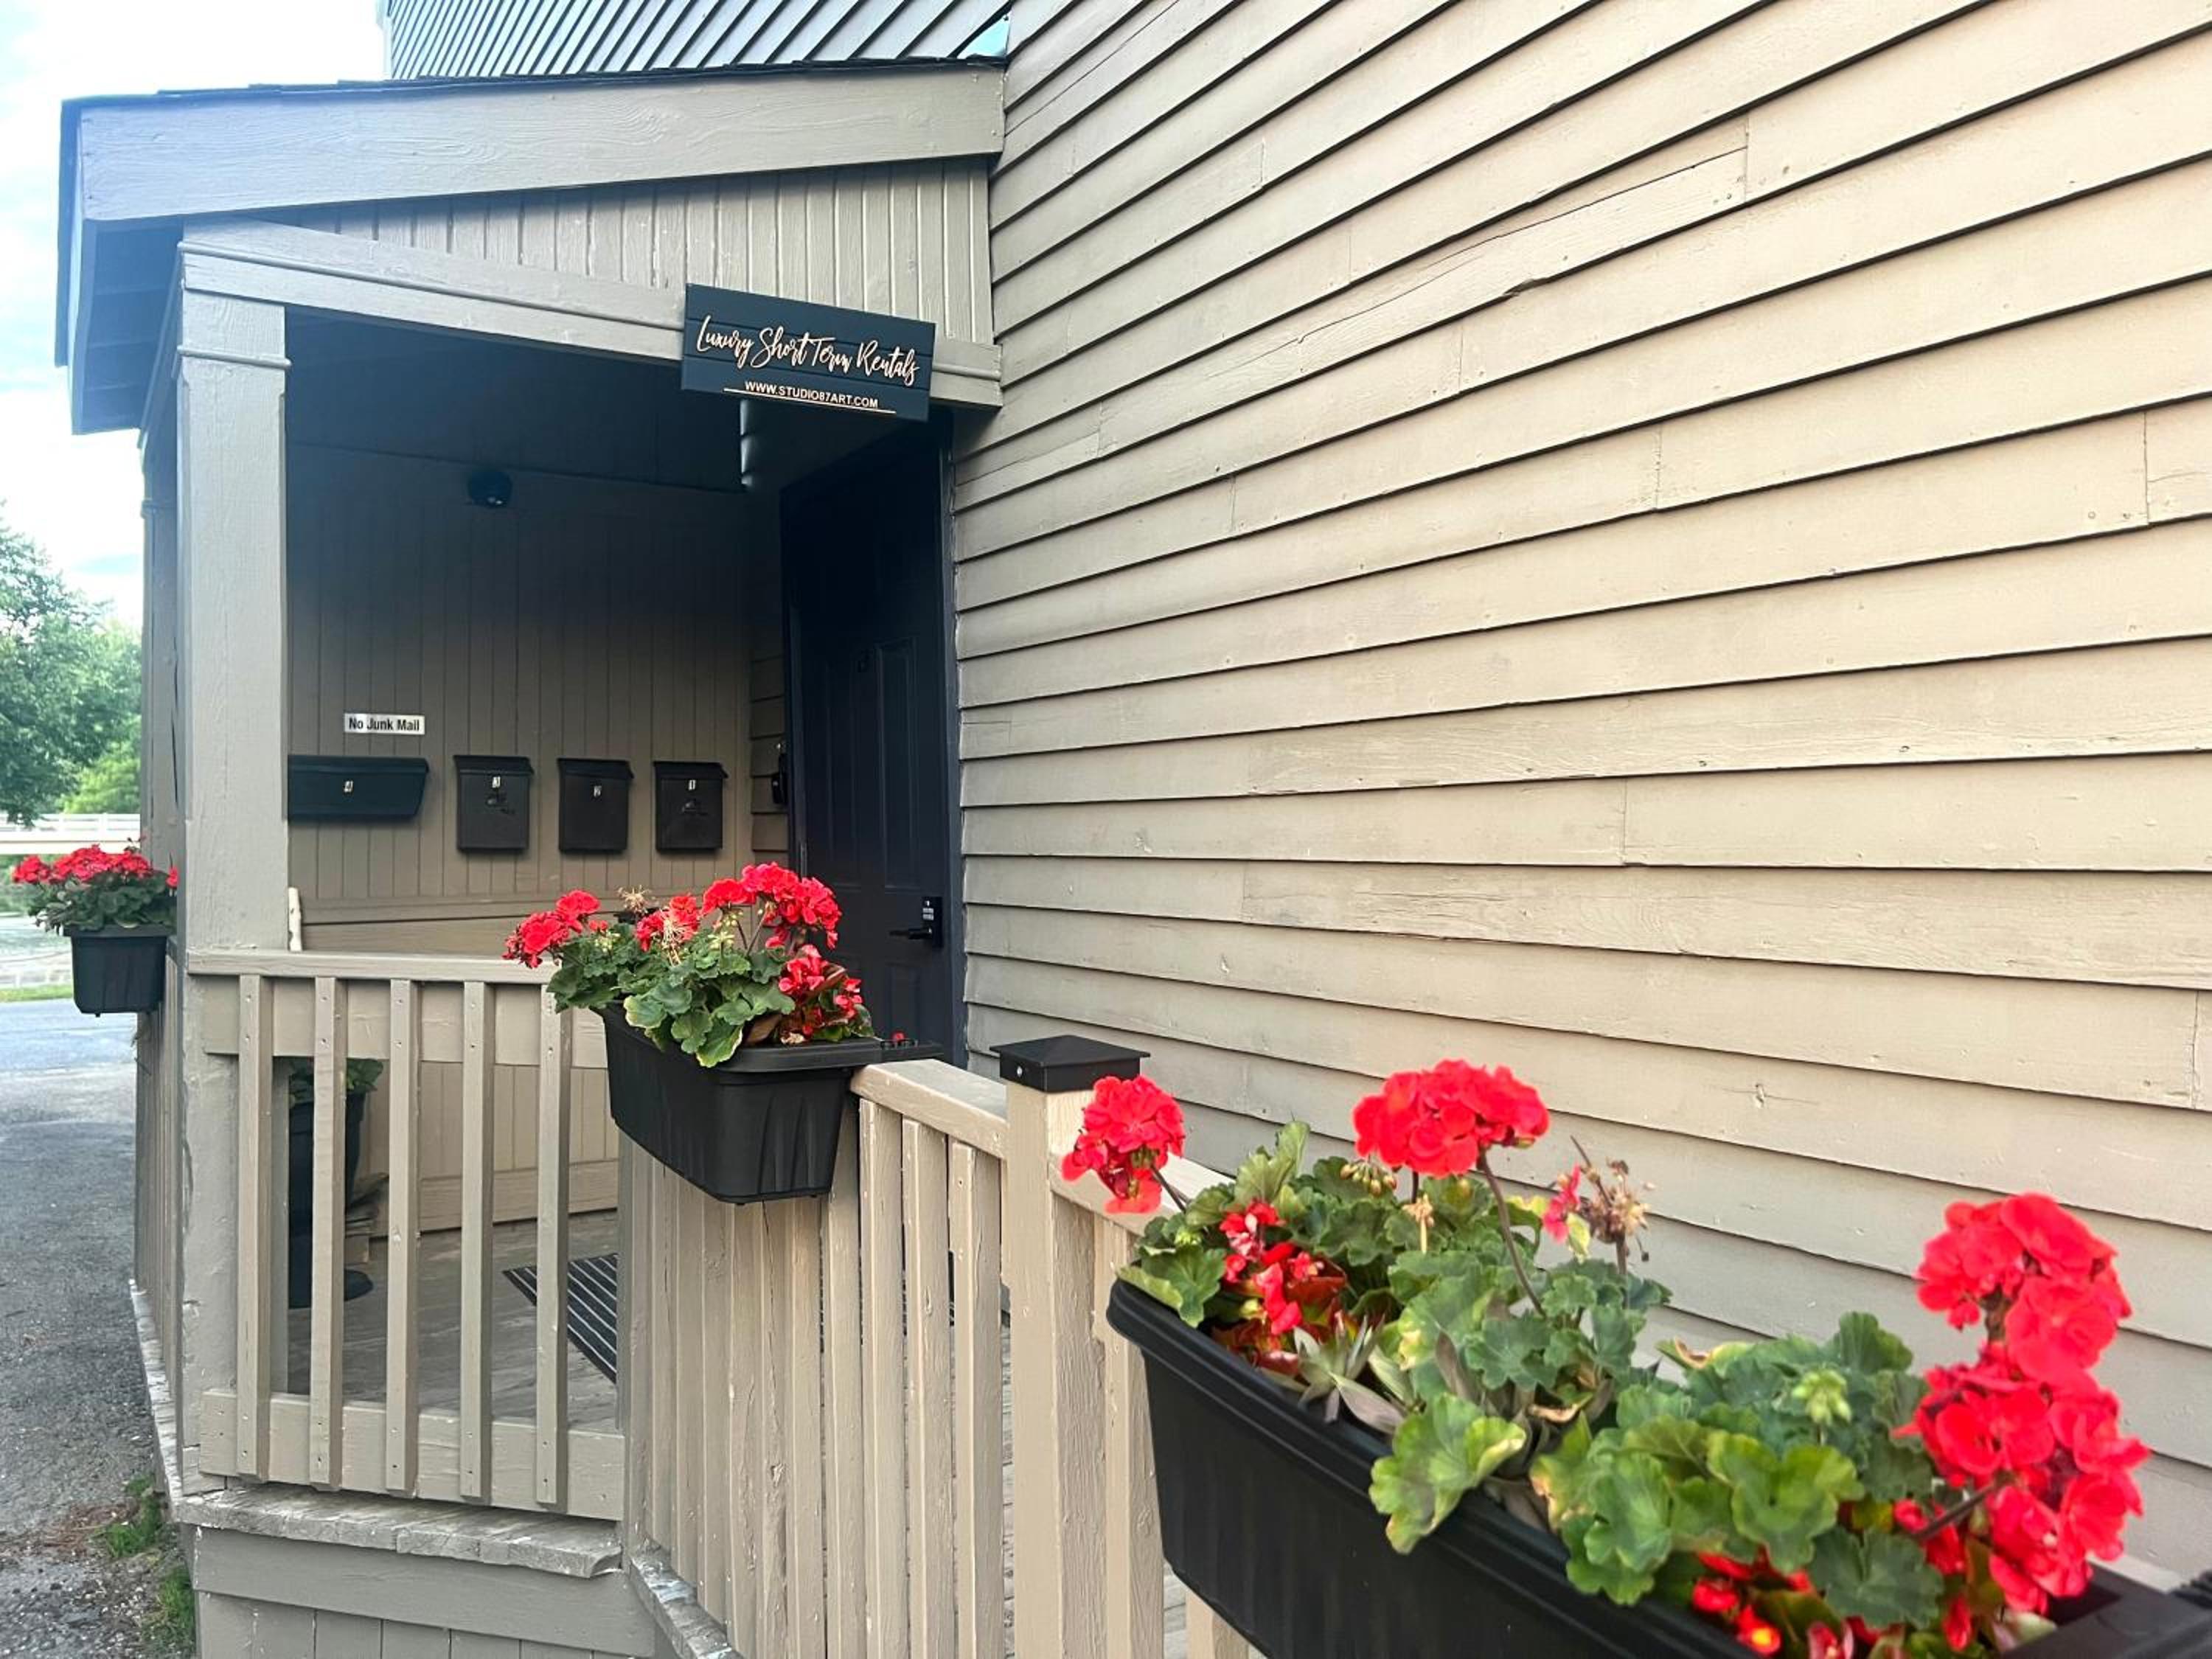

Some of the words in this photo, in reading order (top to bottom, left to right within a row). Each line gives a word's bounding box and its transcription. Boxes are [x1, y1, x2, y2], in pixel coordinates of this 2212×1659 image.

[697, 315, 754, 369] Luxury
[750, 325, 813, 368] Short
[810, 337, 852, 373] Term
[856, 340, 920, 386] Rentals
[744, 380, 878, 408] WWW.STUDIO87ART.COM
[349, 717, 364, 730] No
[366, 718, 393, 731] Junk
[397, 719, 420, 731] Mail
